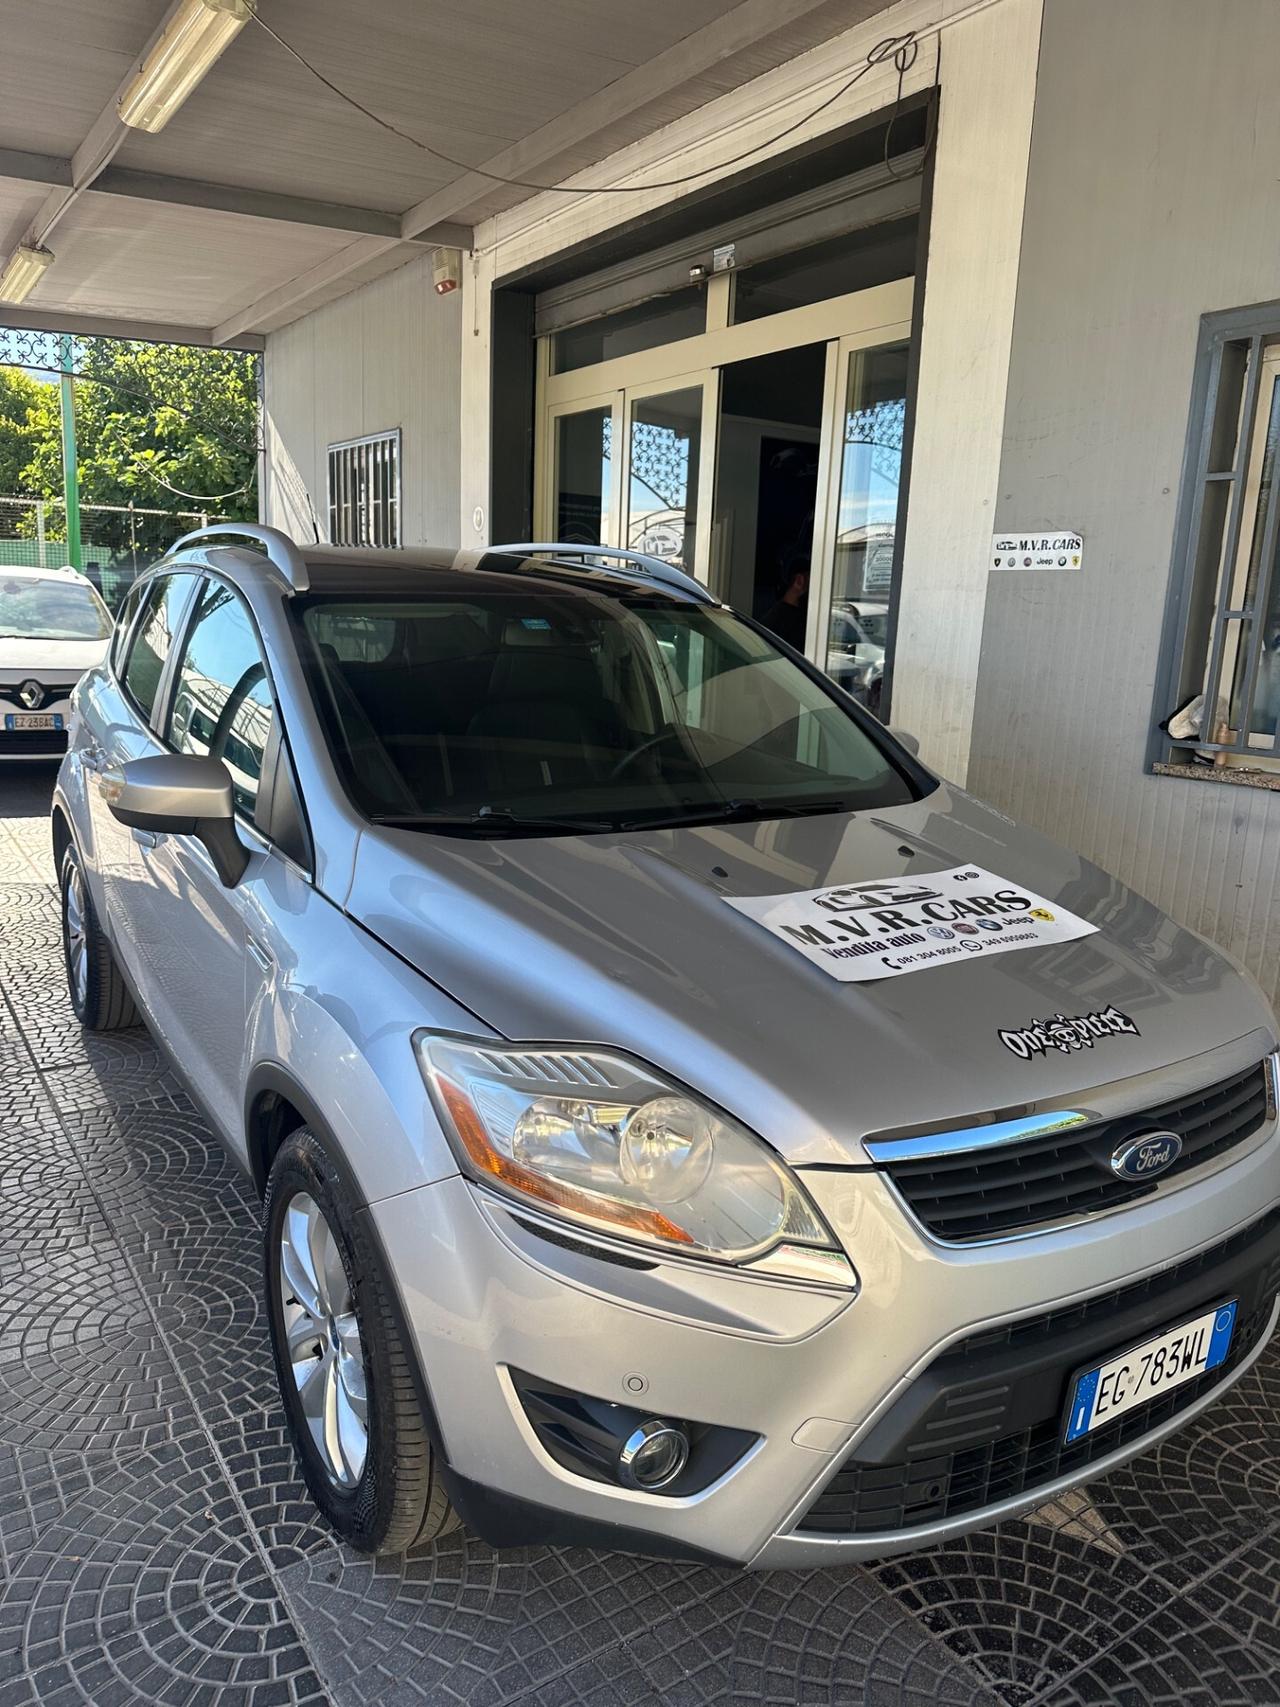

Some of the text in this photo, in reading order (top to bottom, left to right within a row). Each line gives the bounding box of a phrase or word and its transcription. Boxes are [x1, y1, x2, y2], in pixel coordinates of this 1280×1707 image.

[1037, 557, 1053, 566] Jeep
[1001, 916, 1035, 926] Jeep
[820, 932, 927, 959] Vendita auto
[1136, 1141, 1171, 1172] Ford
